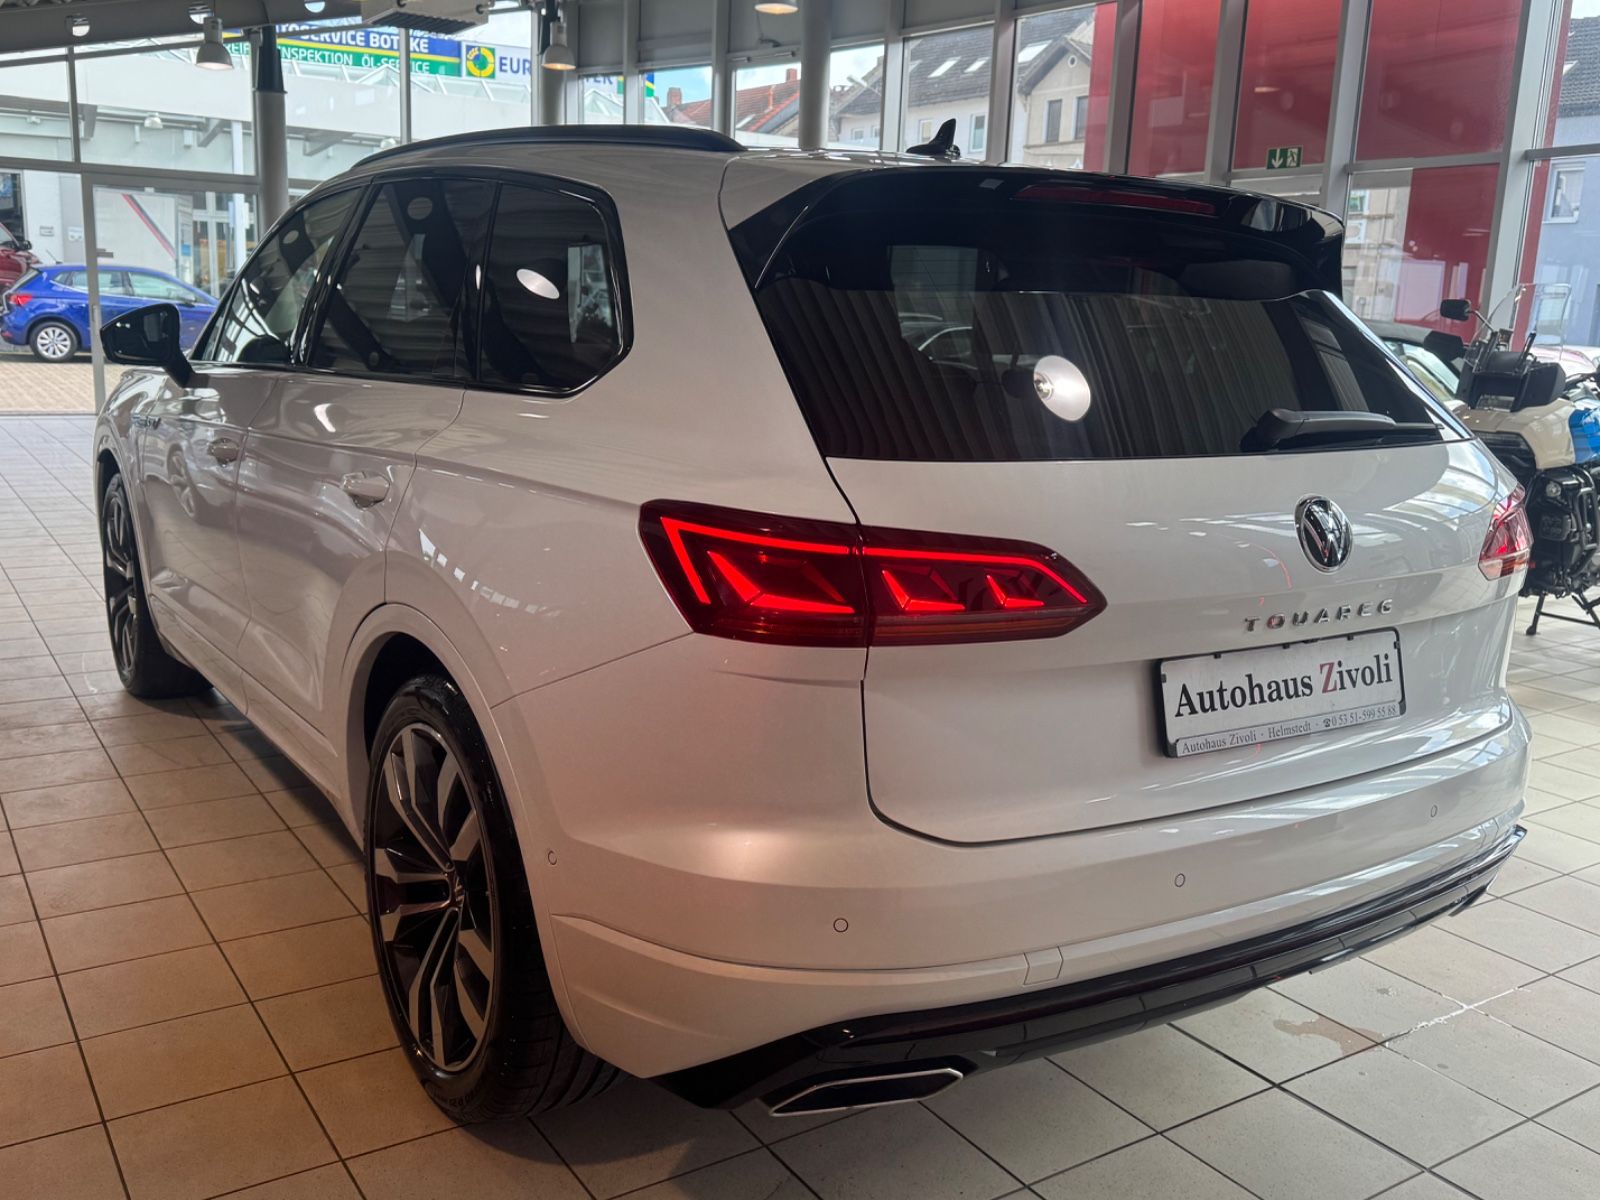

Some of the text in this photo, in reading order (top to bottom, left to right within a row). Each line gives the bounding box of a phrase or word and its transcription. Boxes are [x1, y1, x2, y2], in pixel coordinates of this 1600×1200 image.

[278, 46, 353, 66] NSPEKTION
[369, 32, 429, 53] BOTKE
[1244, 598, 1394, 633] TOUAREG
[1174, 653, 1393, 718] Autohaus Zivoli
[1181, 737, 1227, 755] Autohaus
[1229, 731, 1257, 745] Zivoli
[1268, 721, 1312, 739] Helmstedt
